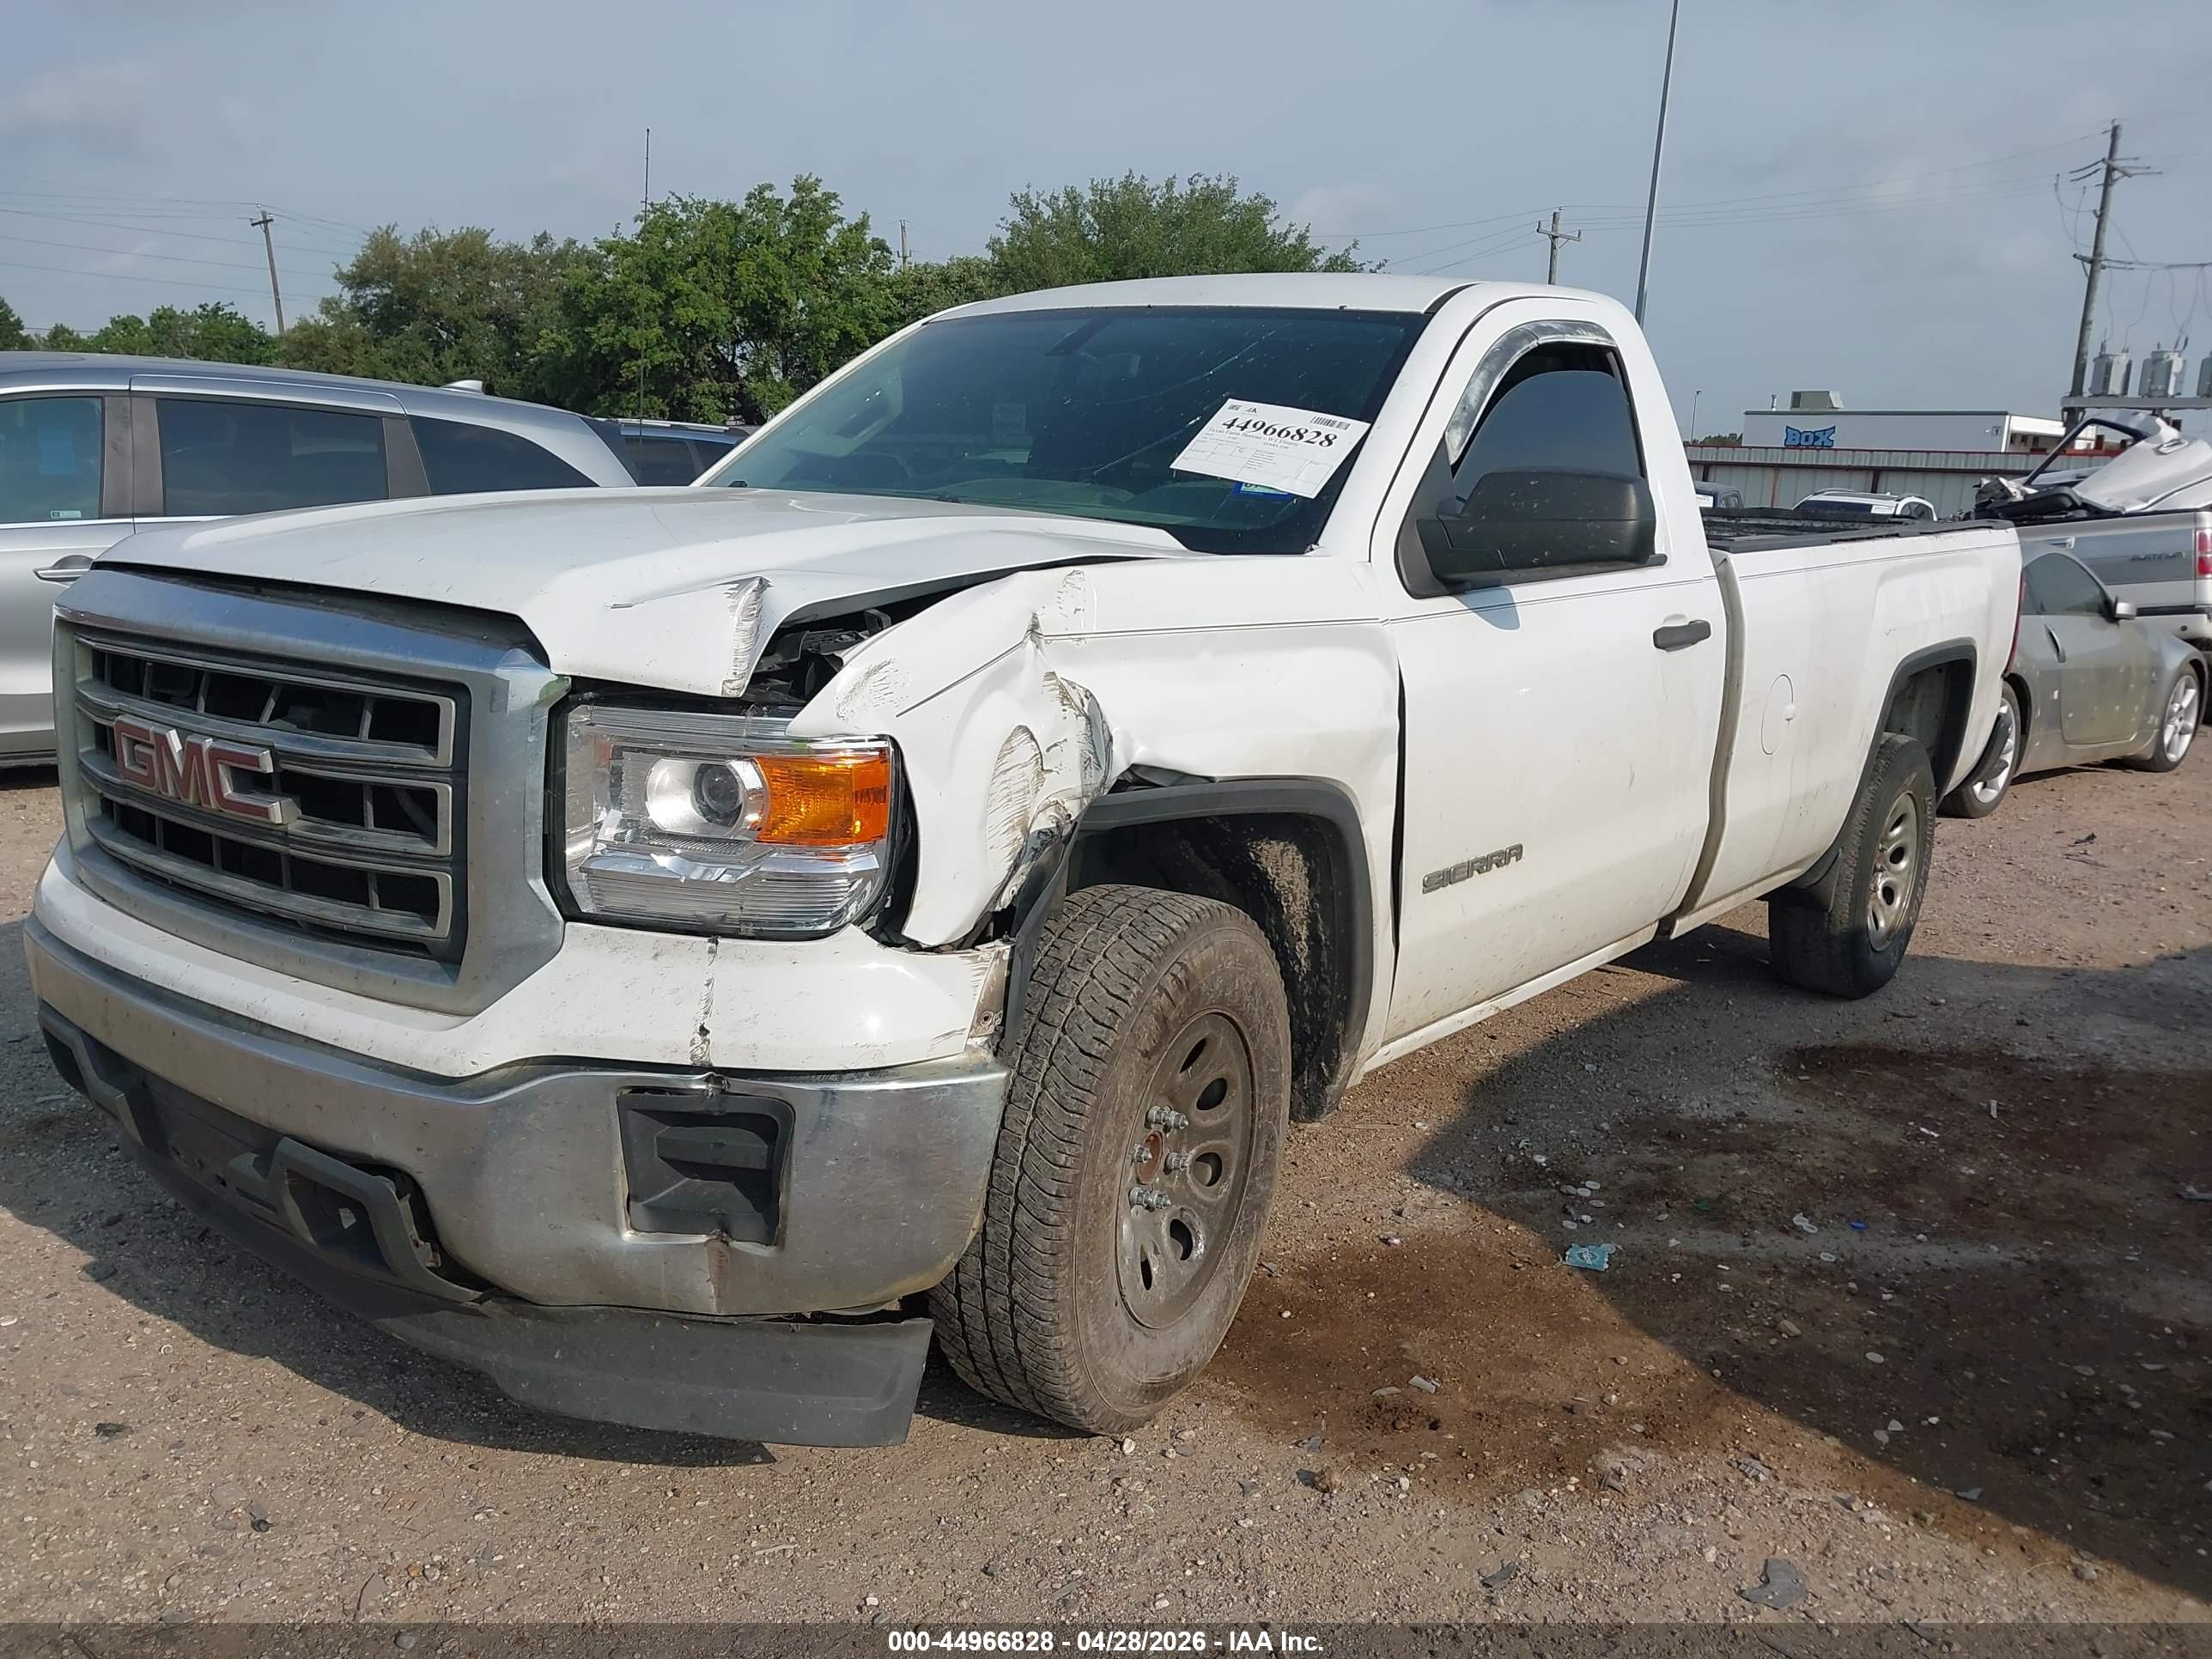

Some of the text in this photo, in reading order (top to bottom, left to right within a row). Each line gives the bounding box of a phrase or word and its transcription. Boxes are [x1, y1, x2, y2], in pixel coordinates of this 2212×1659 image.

[1222, 417, 1337, 447] 44966828
[1784, 425, 1836, 447] BOX
[114, 714, 283, 824] GMC
[1422, 843, 1523, 894] SIERRA
